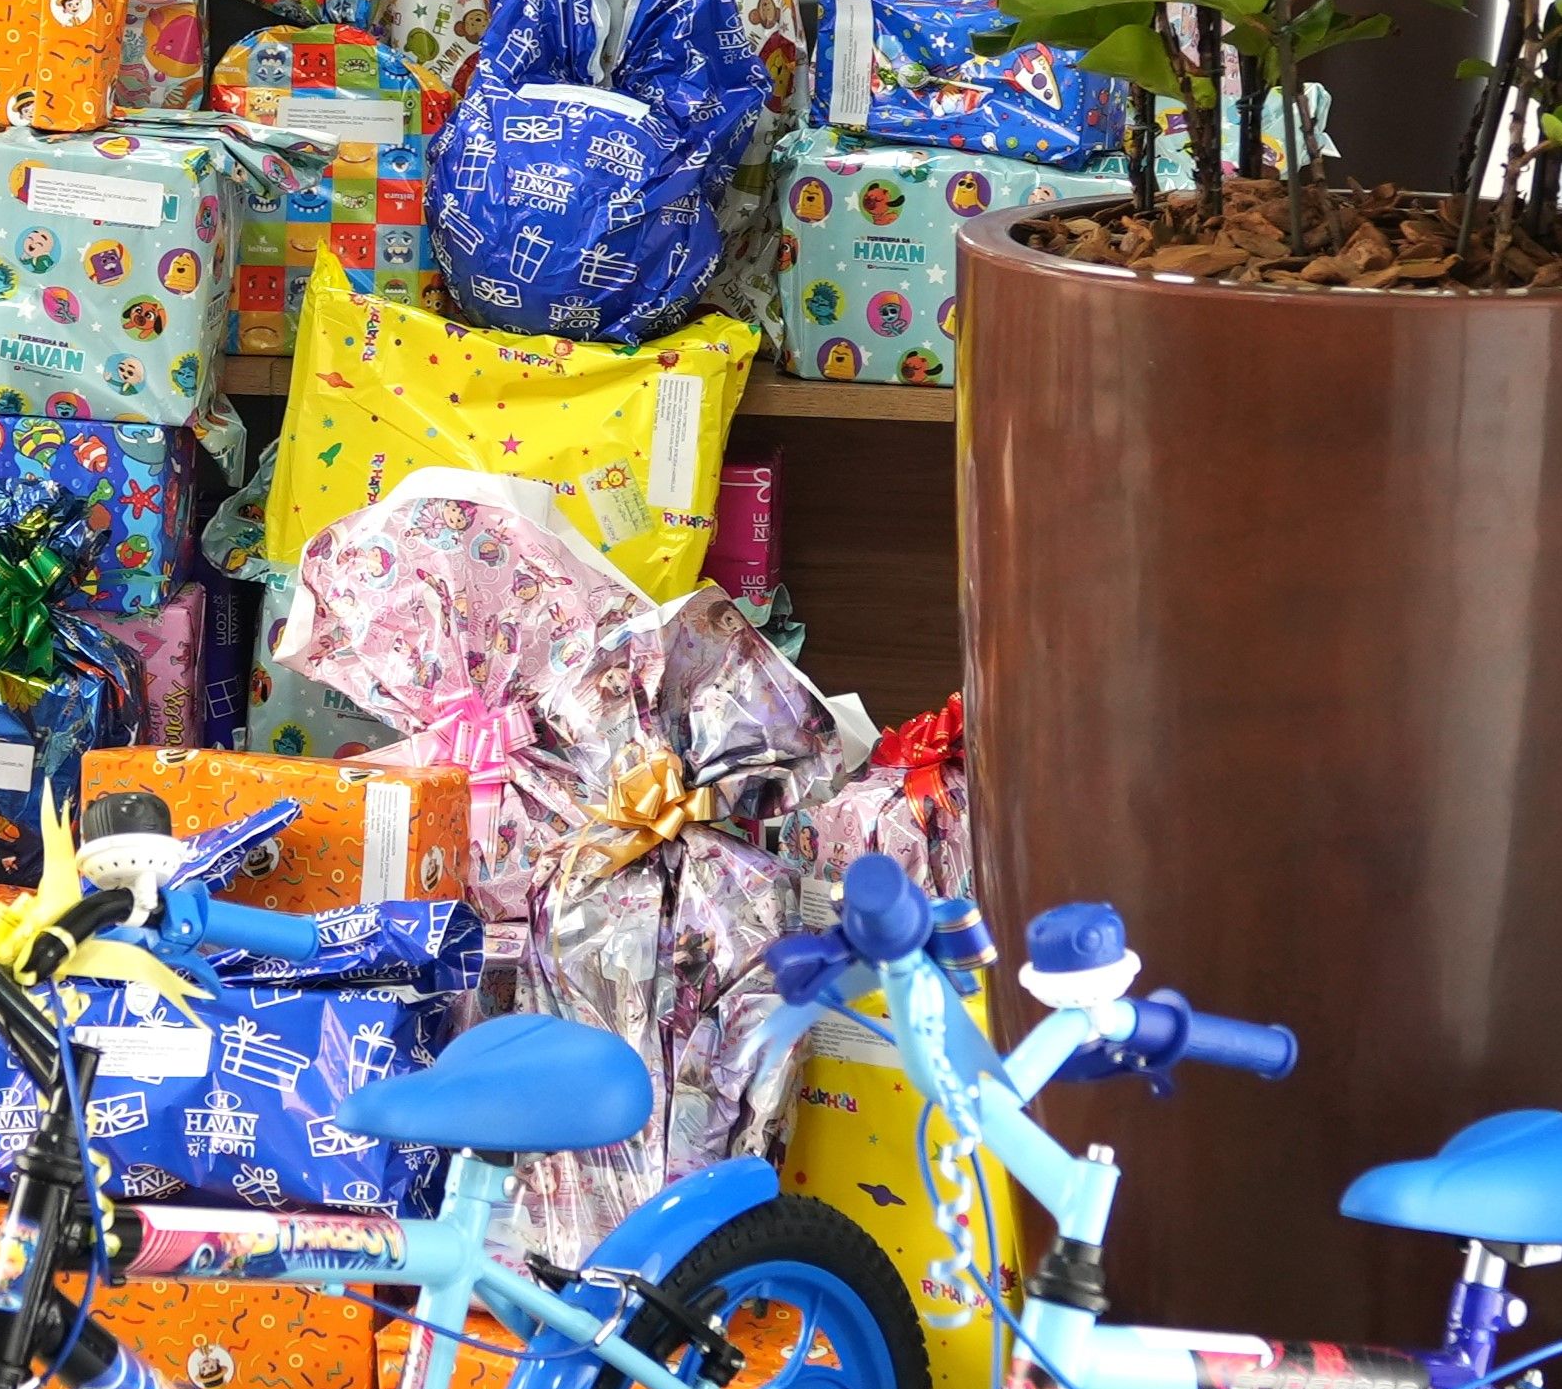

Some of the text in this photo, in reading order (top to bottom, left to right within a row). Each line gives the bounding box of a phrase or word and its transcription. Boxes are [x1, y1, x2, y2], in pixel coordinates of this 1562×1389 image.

[589, 137, 646, 167] HAVAN
[601, 161, 642, 183] .com
[513, 173, 572, 200] HAVAN
[526, 197, 567, 216] .com
[853, 241, 926, 264] HAVAN
[0, 339, 85, 374] HAVAN
[186, 1112, 258, 1137] HAVAN
[208, 1137, 256, 1159] .com
